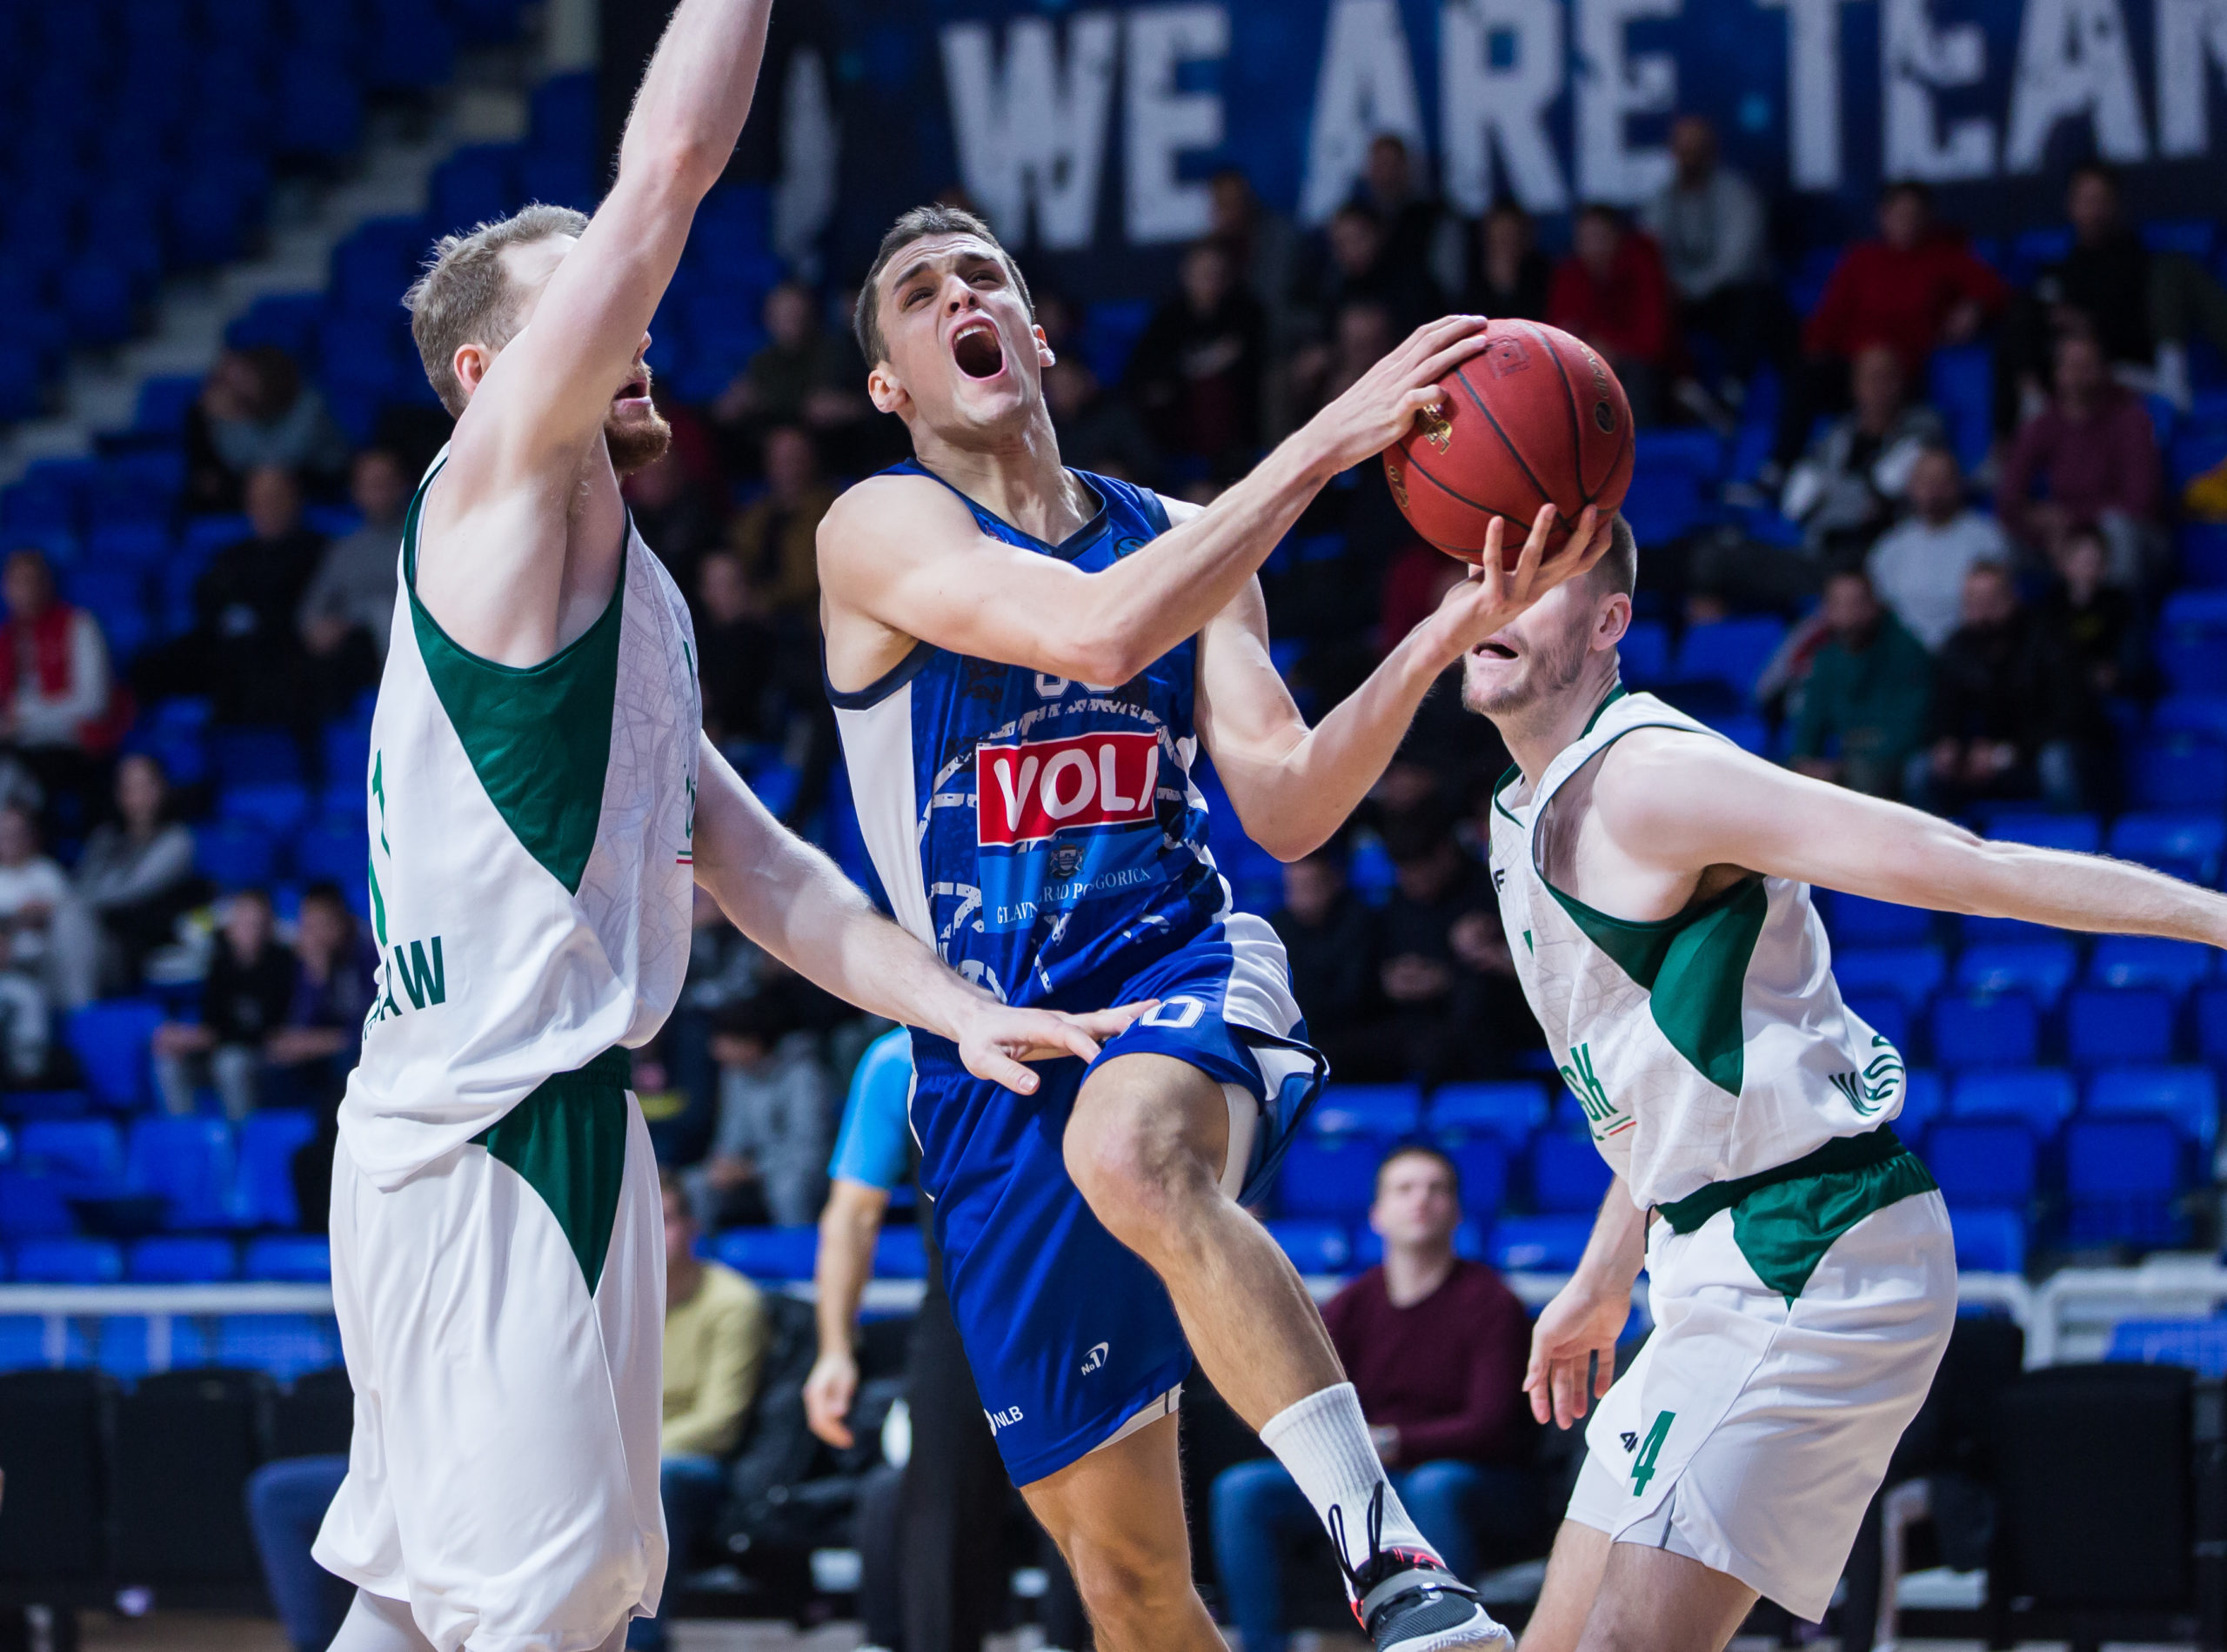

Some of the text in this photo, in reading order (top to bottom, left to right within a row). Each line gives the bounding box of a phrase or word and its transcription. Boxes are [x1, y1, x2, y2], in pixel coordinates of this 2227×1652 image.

[940, 7, 1229, 250] WE
[1296, 0, 1681, 226] ARE
[997, 900, 1039, 924] GLAVN
[1039, 883, 1070, 905] RAD
[993, 1406, 1024, 1428] NLB
[1630, 1410, 1677, 1497] 4
